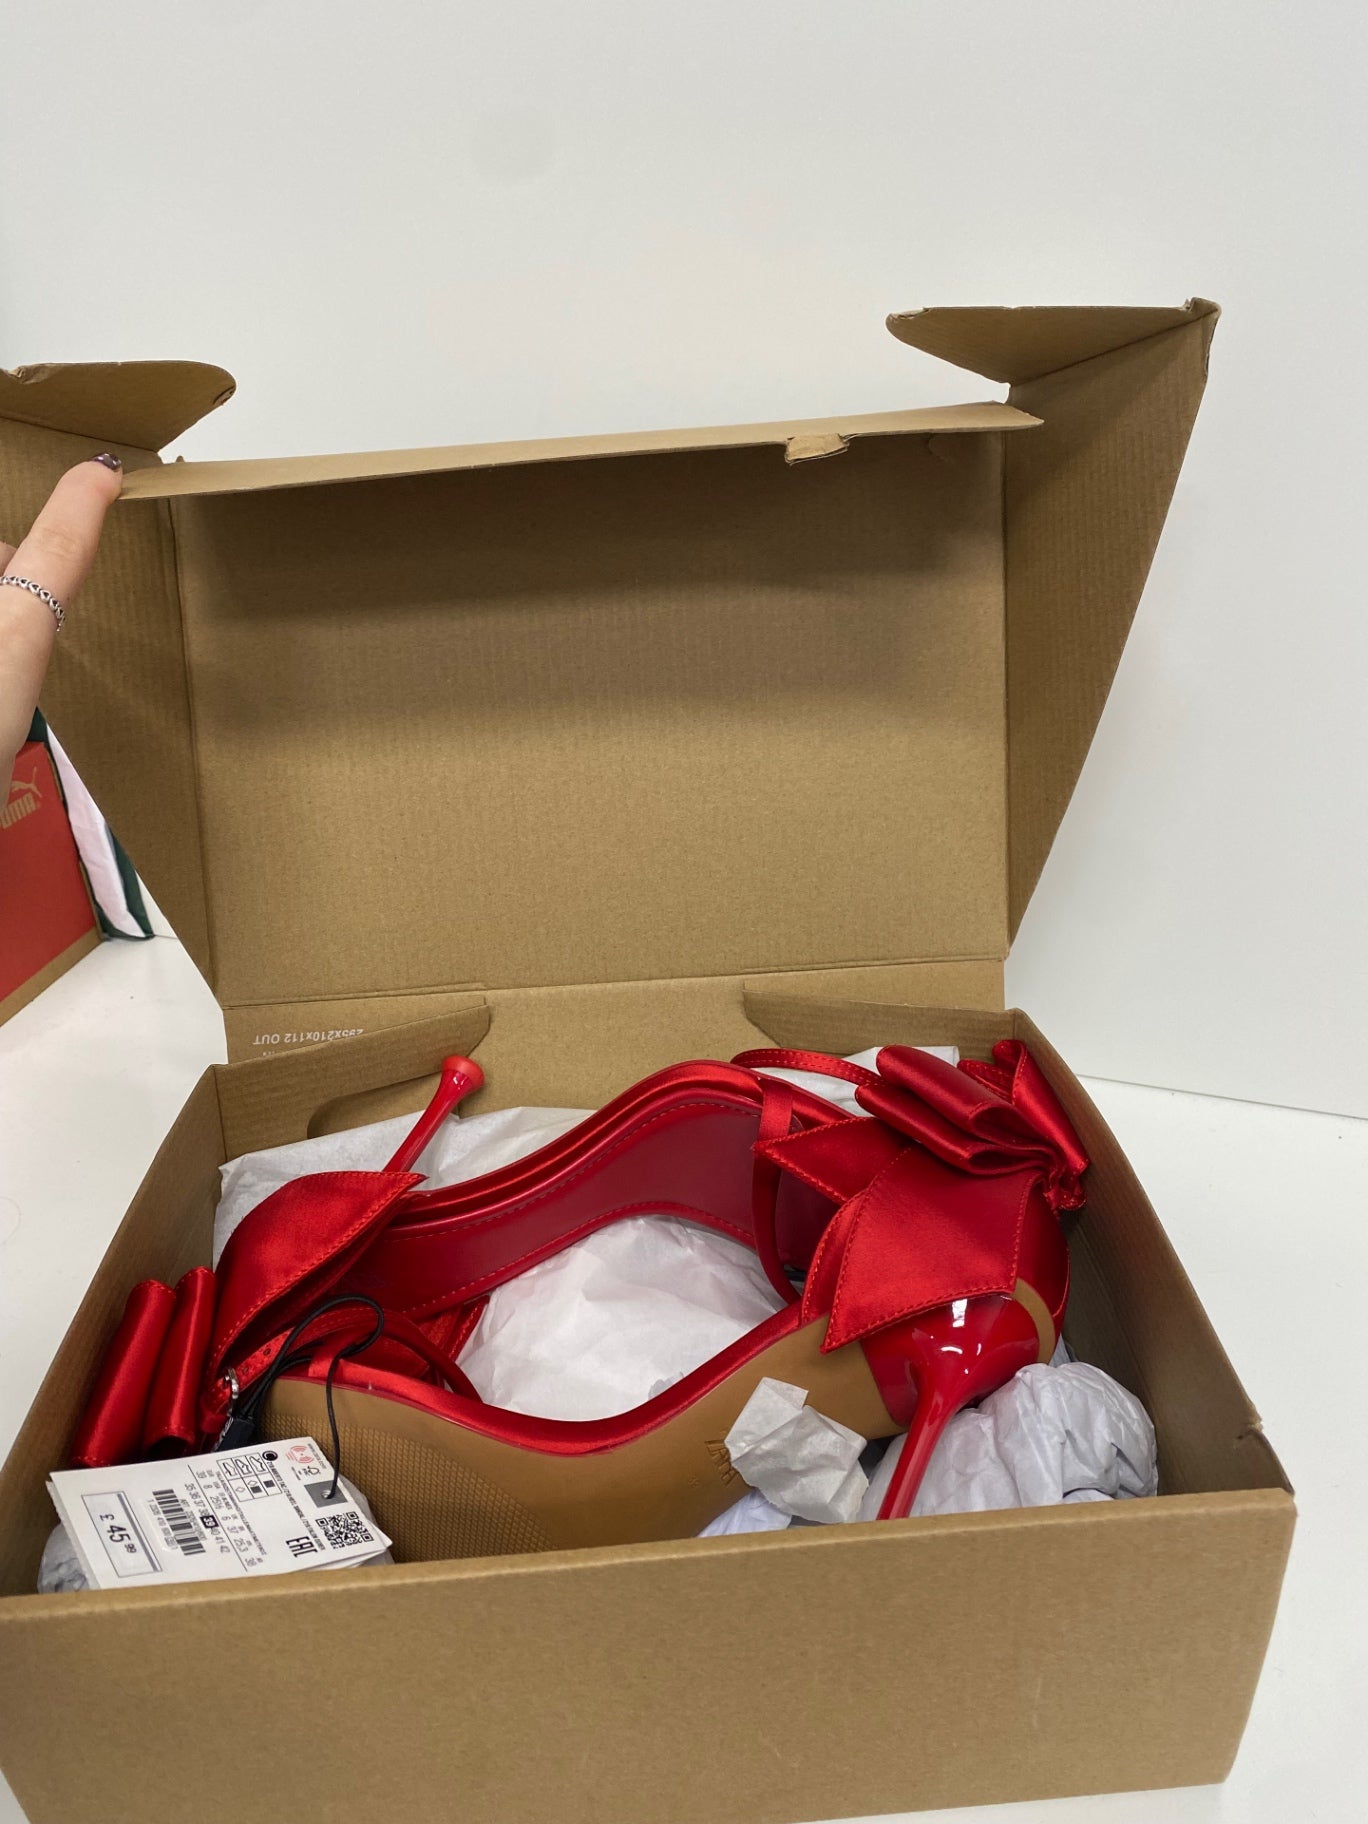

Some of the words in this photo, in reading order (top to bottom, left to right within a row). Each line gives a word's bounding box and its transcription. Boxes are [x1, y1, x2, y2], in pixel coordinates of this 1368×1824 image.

[0, 792, 36, 829] UMA
[252, 1033, 280, 1046] OUT
[106, 1523, 131, 1543] 45
[125, 1543, 136, 1553] 99
